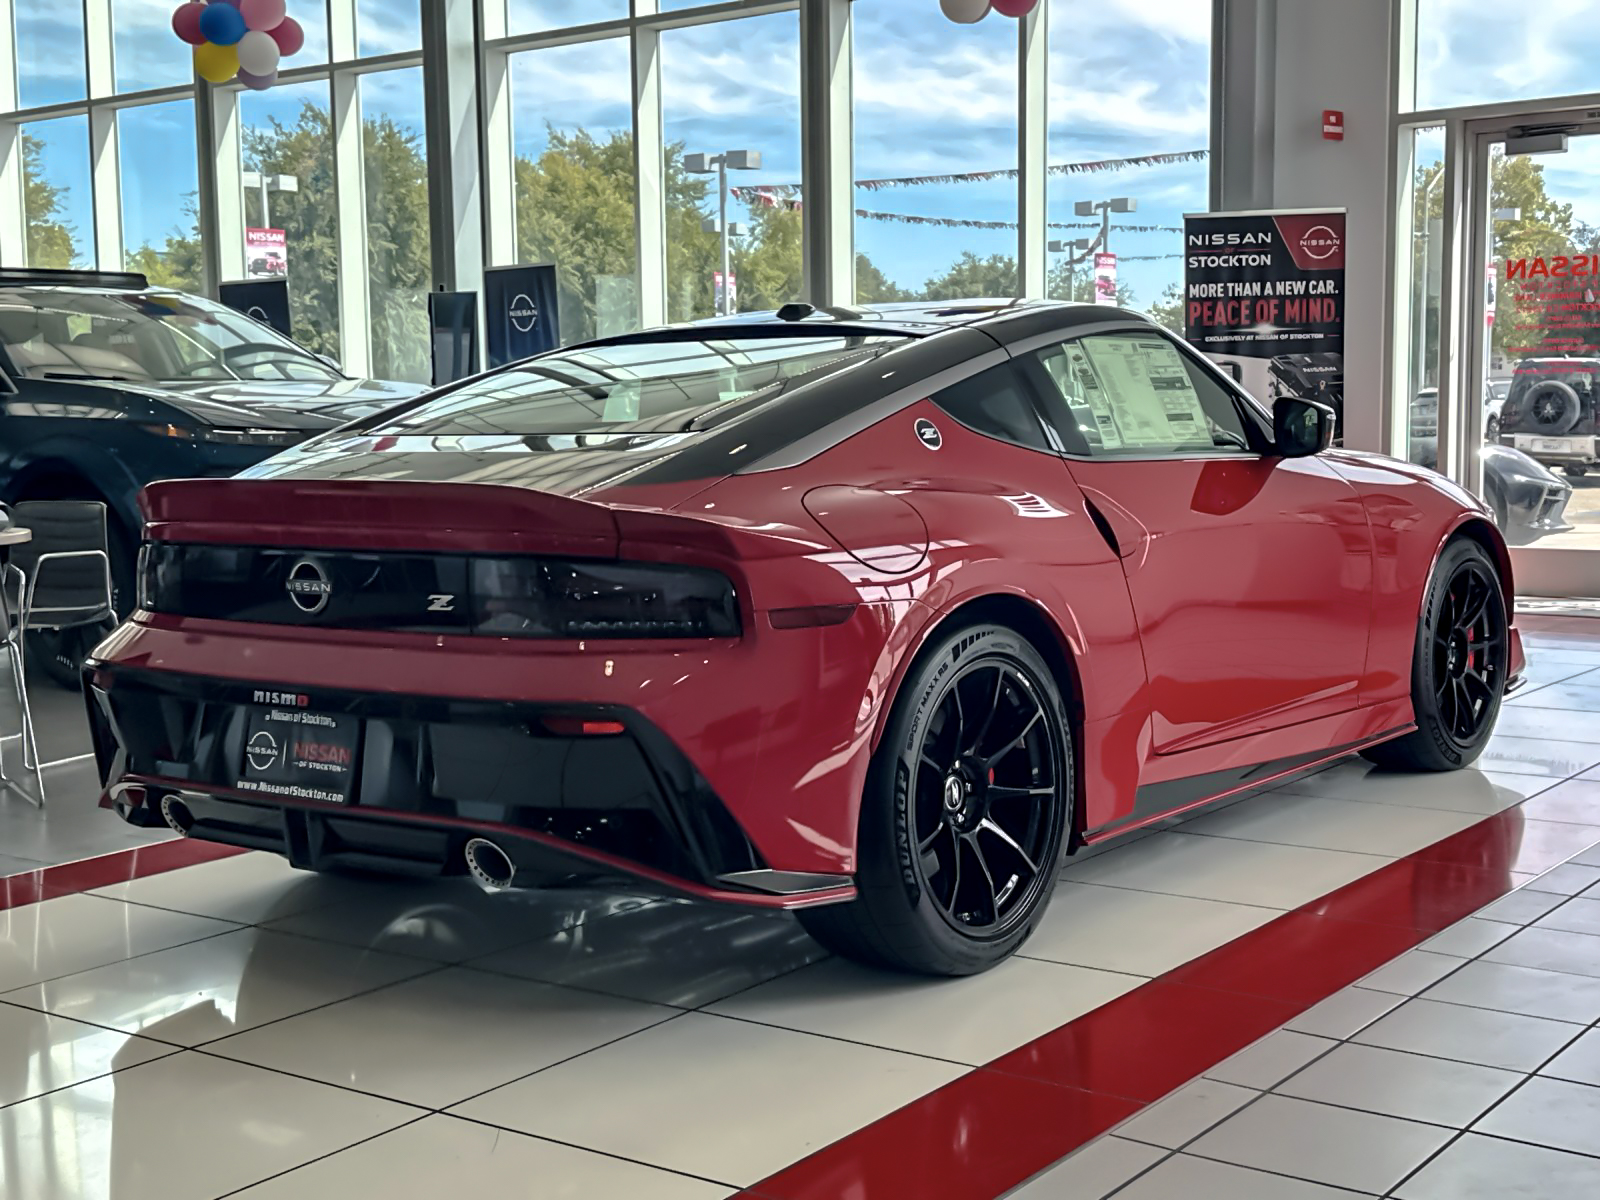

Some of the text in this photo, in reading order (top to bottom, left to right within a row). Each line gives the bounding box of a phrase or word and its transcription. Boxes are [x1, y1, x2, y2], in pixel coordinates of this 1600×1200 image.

[248, 231, 285, 242] NISSAN
[1189, 233, 1271, 246] NISSAN
[1189, 254, 1271, 268] STOCKTON
[1189, 280, 1339, 298] MORE THAN A NEW CAR.
[509, 309, 538, 317] NISSAN
[1189, 298, 1341, 327] PEACE OF MIND.
[286, 582, 331, 592] NISSAN
[426, 594, 455, 611] Z
[271, 709, 333, 727] Nissan of Stockton
[907, 707, 923, 751] SPORT
[921, 675, 940, 707] MAXX
[246, 745, 278, 756] NISSAN
[294, 742, 351, 764] NISSAN
[298, 760, 342, 773] OF STOCKTON
[237, 780, 344, 803] www.NissanofStockton.com
[896, 769, 916, 884] DUNLOP
